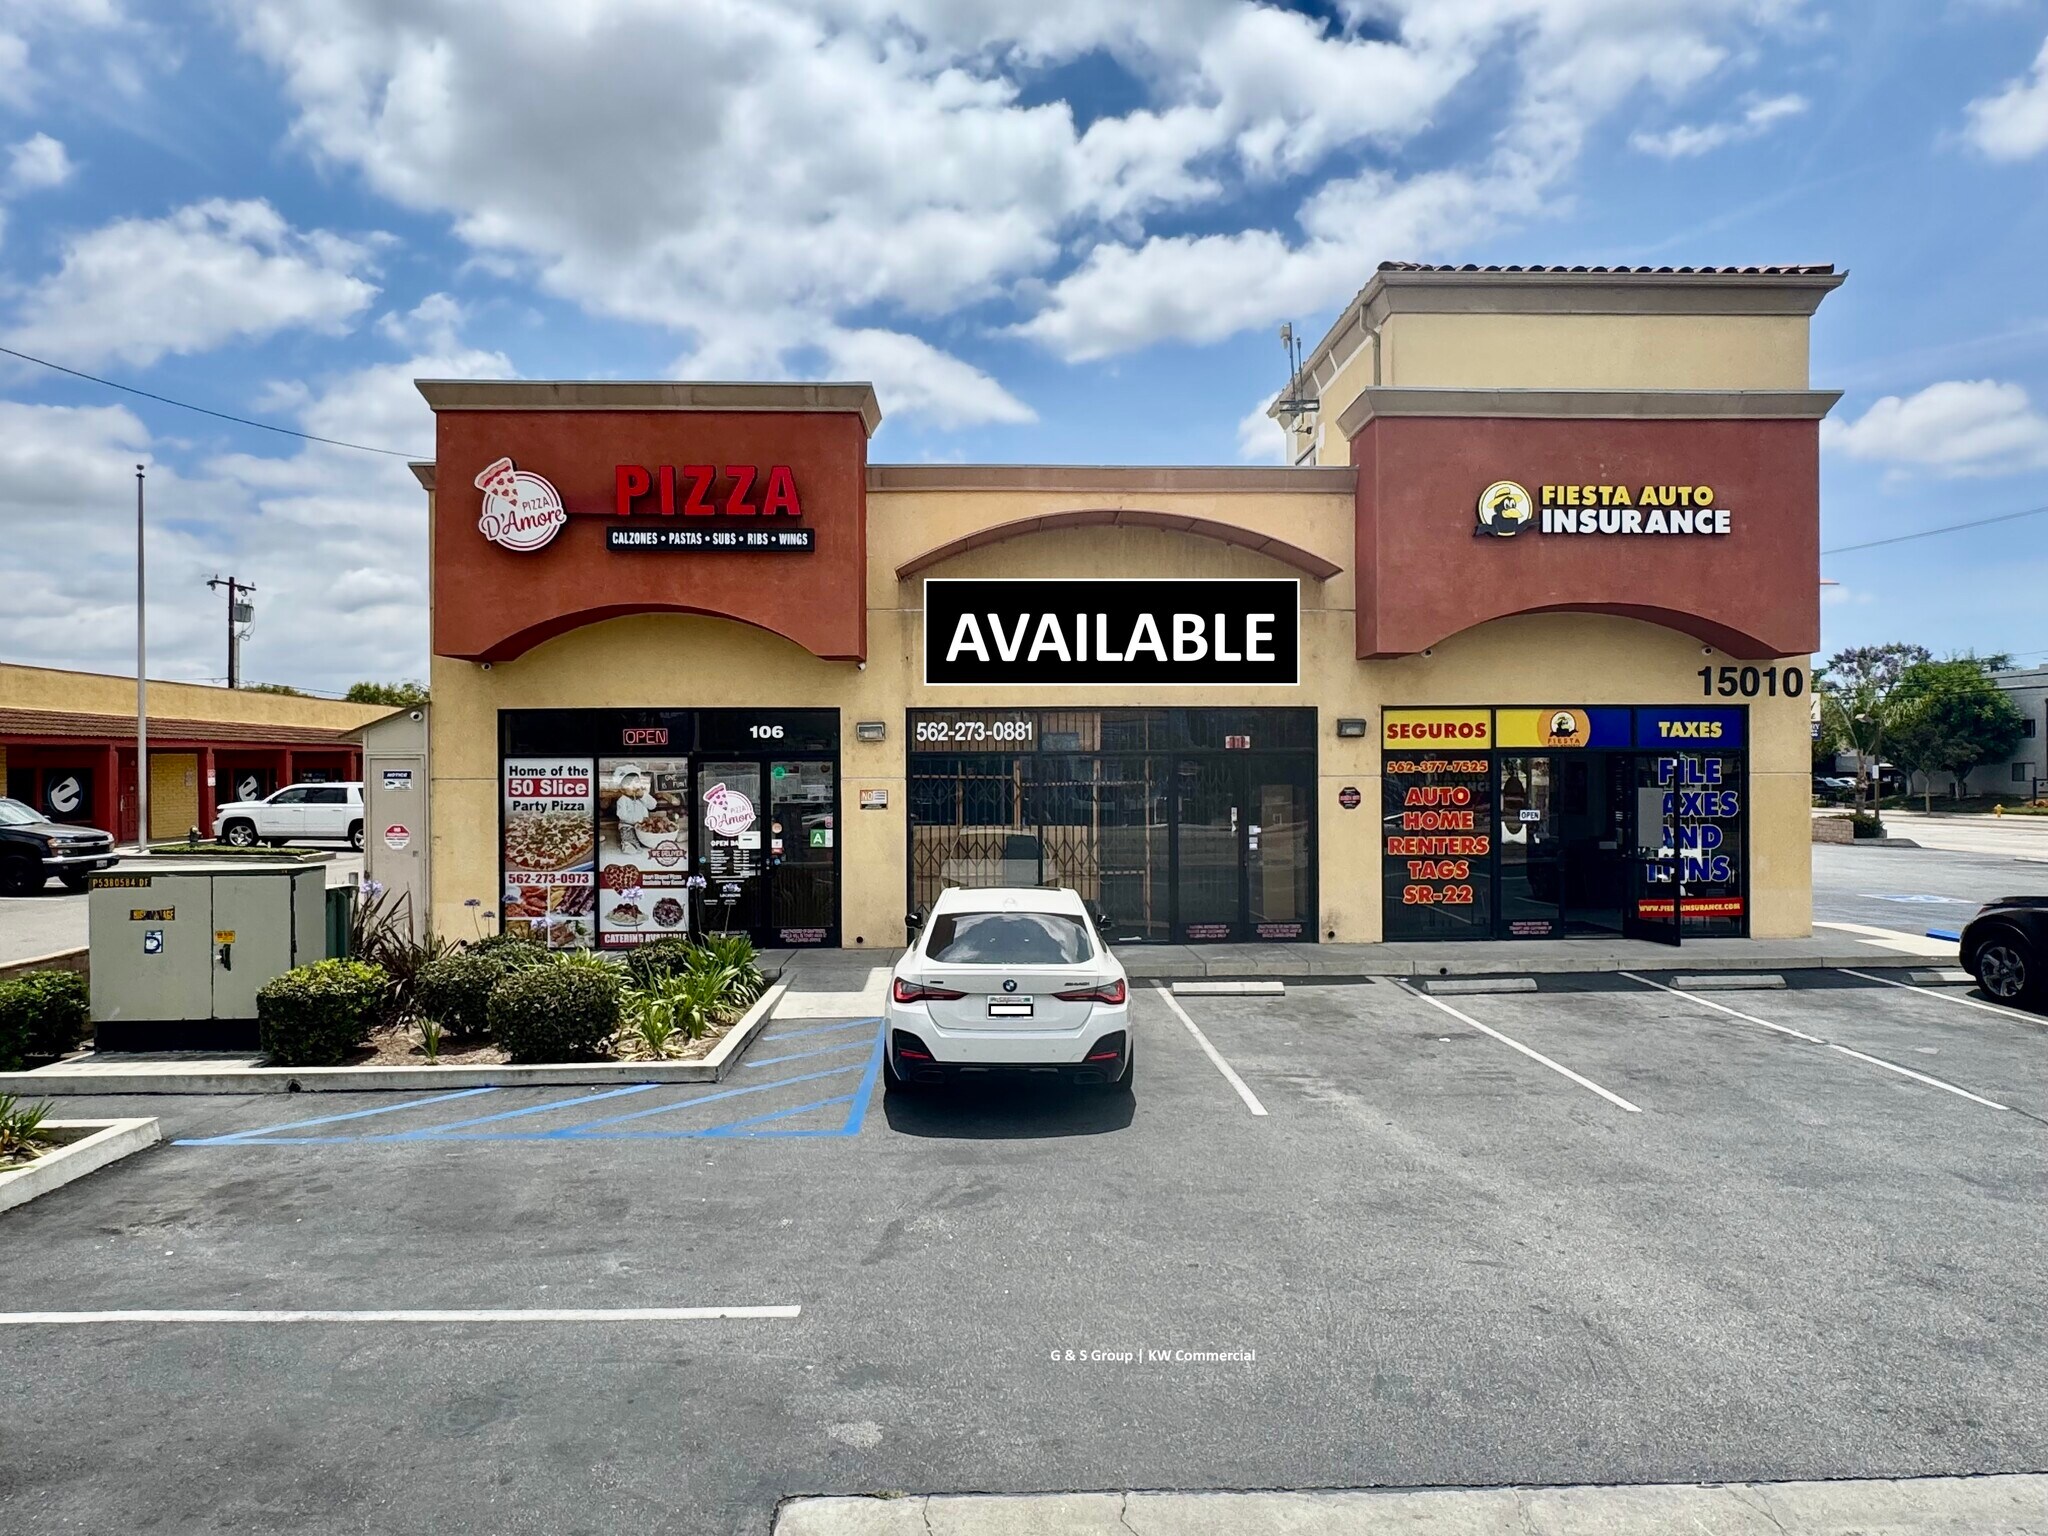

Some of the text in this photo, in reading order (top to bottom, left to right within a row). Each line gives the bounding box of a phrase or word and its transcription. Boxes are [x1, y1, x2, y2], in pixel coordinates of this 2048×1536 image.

[615, 464, 800, 516] PIZZA
[1542, 485, 1714, 506] FIESTA AUTO
[522, 497, 550, 512] PIZZA
[481, 509, 565, 539] D'Amore
[1542, 509, 1731, 534] INSURANCE
[612, 531, 808, 545] CALZONES PASTAS SUBS RIBS WINGS
[1697, 666, 1804, 697] 15010
[625, 730, 667, 744] OPEN
[749, 725, 784, 739] 106
[916, 721, 1033, 742] 562-273-0881
[1386, 722, 1487, 739] SEGUROS
[1658, 721, 1723, 738] TAXES
[509, 765, 588, 776] Home of the
[1386, 760, 1489, 773] 562-377-7525
[511, 779, 587, 795] 50 Slice
[1404, 786, 1471, 806] AUTO
[1662, 791, 1739, 817] AXES
[513, 801, 585, 813] Party Pizza
[1521, 811, 1539, 819] OPEN
[1403, 811, 1474, 830] HOME
[813, 833, 823, 844] A
[1387, 836, 1490, 855] RENTERS
[508, 873, 590, 884] 562-273-0973
[1407, 860, 1470, 880] TAGS
[1402, 885, 1473, 904] SR-22
[604, 933, 643, 944] CATERING
